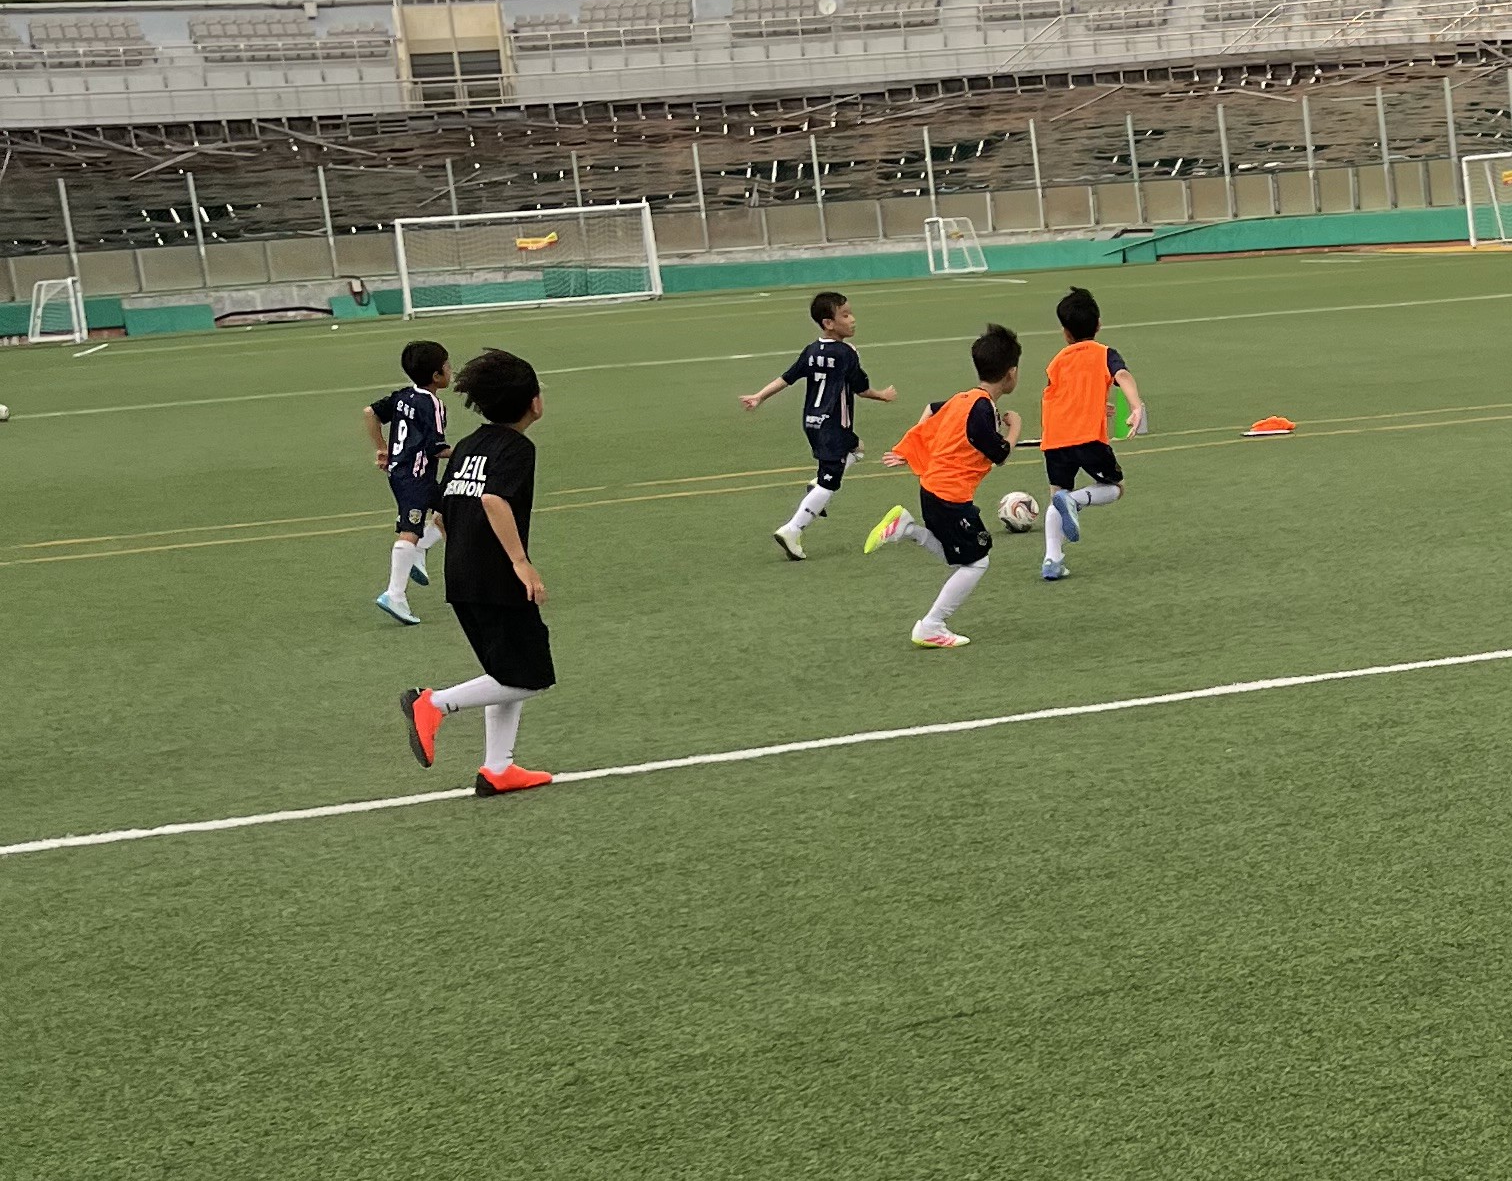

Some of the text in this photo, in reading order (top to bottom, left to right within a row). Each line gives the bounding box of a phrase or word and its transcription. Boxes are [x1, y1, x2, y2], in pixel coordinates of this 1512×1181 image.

[814, 372, 827, 408] 7
[392, 419, 408, 456] 9
[453, 455, 488, 482] JEIL
